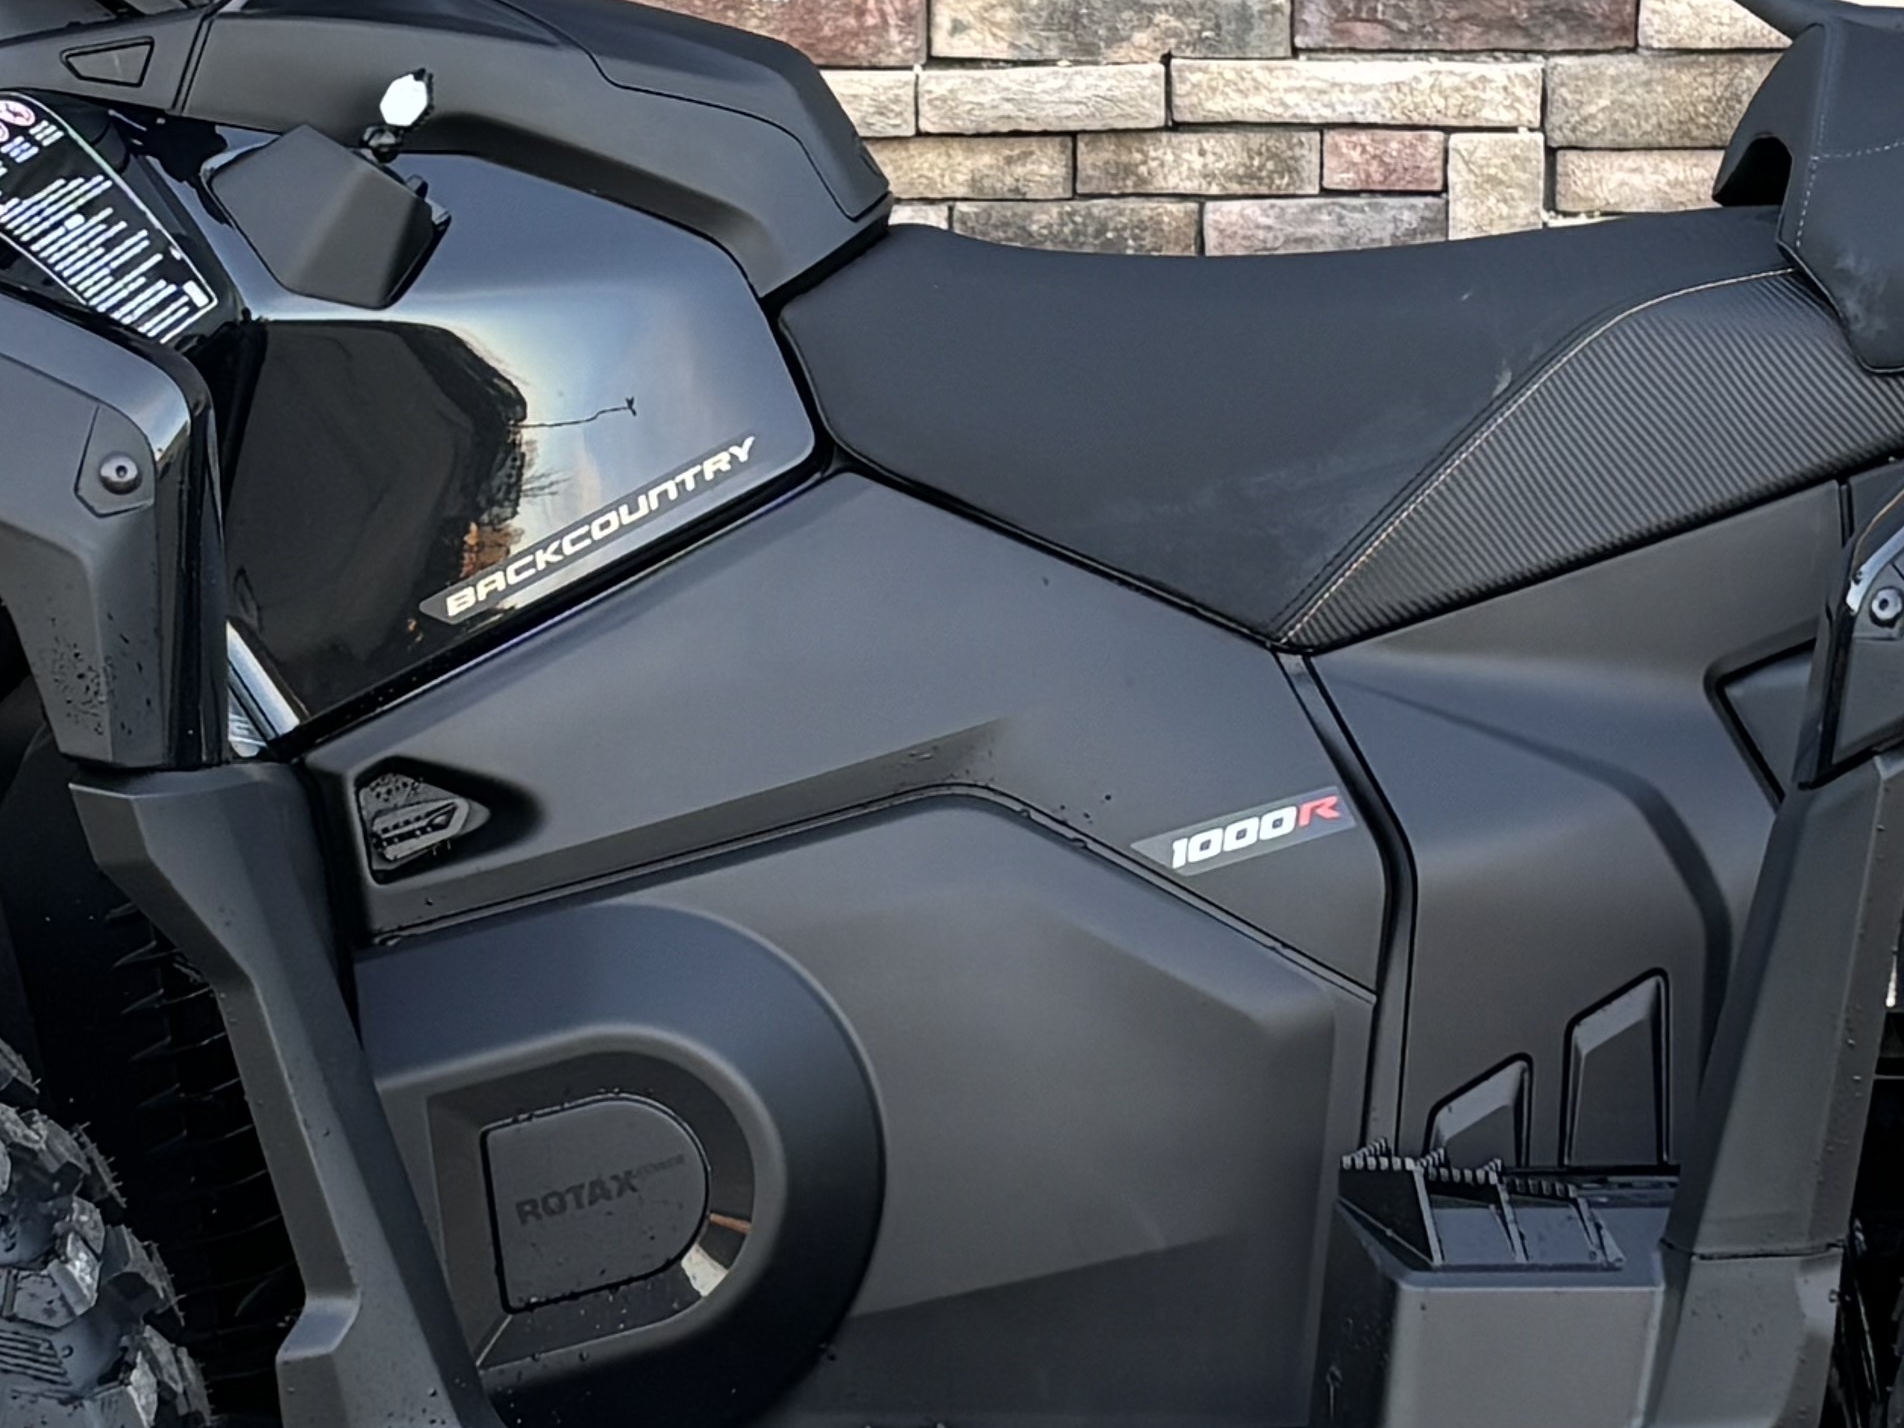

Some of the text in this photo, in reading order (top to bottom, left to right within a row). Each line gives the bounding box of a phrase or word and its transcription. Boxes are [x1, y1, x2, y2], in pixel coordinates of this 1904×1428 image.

[445, 434, 756, 618] BACKCOUNTRY
[1171, 794, 1342, 870] 1000R
[515, 1168, 639, 1226] ROTAX
